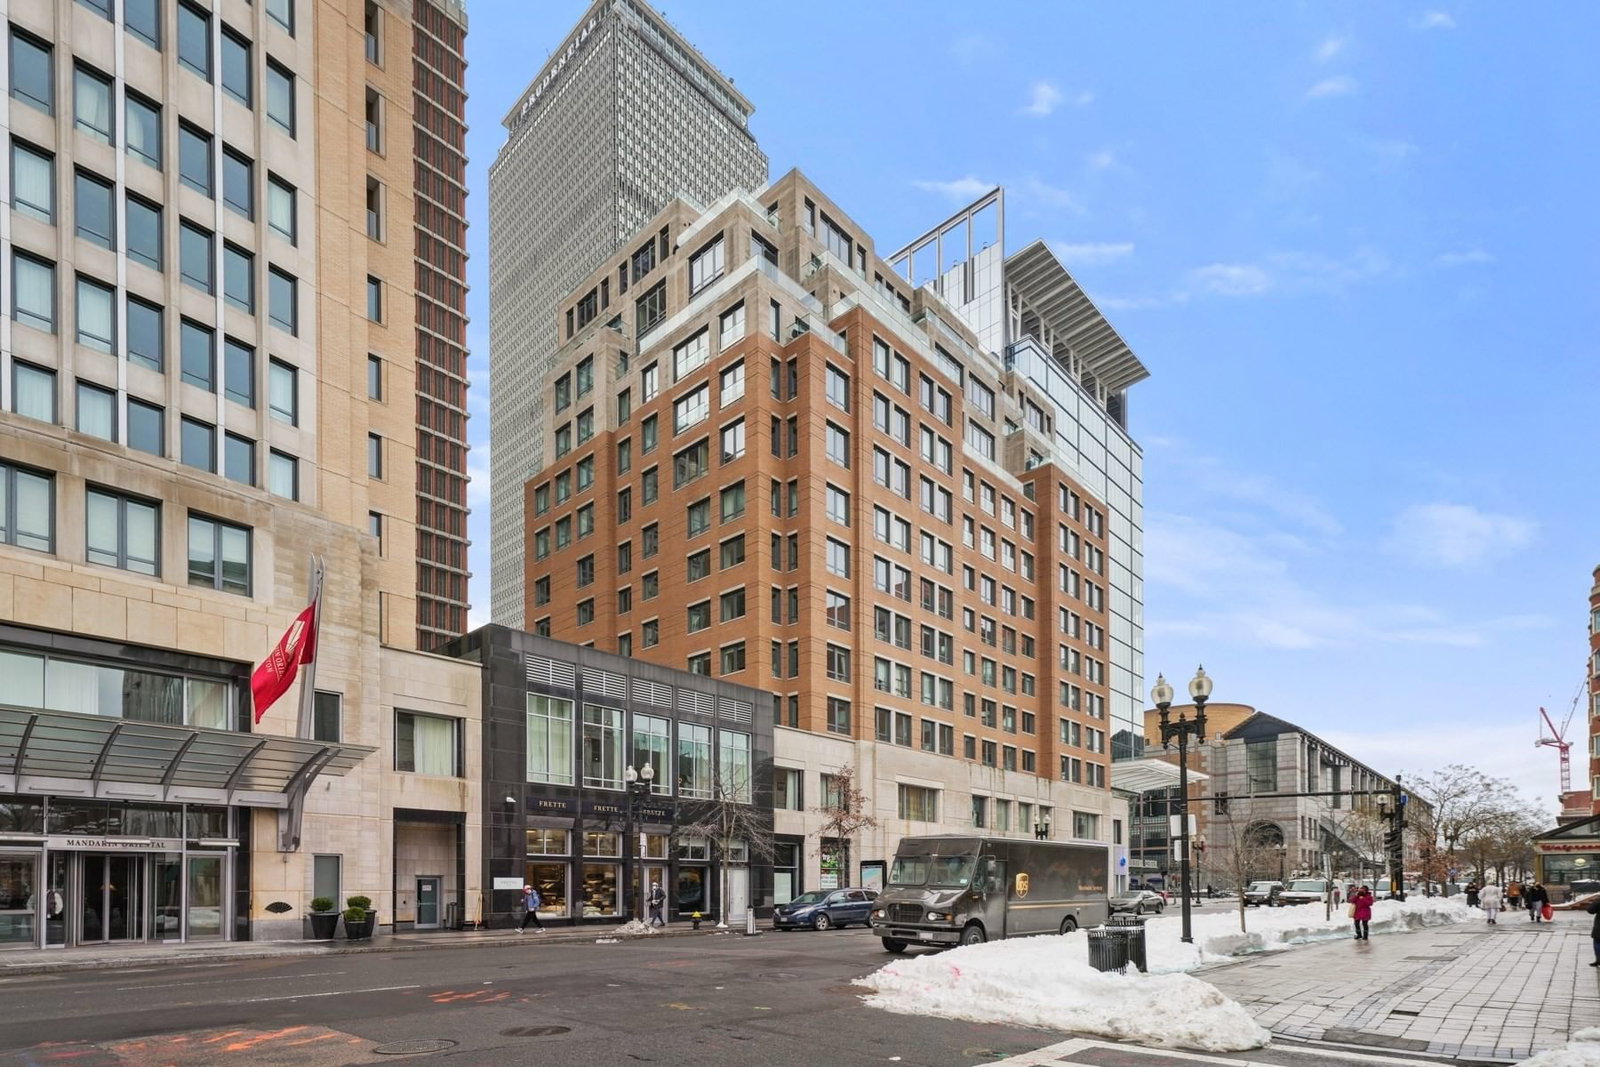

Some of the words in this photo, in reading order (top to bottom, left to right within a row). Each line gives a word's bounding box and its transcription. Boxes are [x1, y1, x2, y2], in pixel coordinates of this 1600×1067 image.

[521, 18, 597, 117] PRUDENTIAL
[539, 800, 567, 809] FRETTE
[594, 804, 618, 813] FRETTE
[66, 839, 118, 847] MANDARIN
